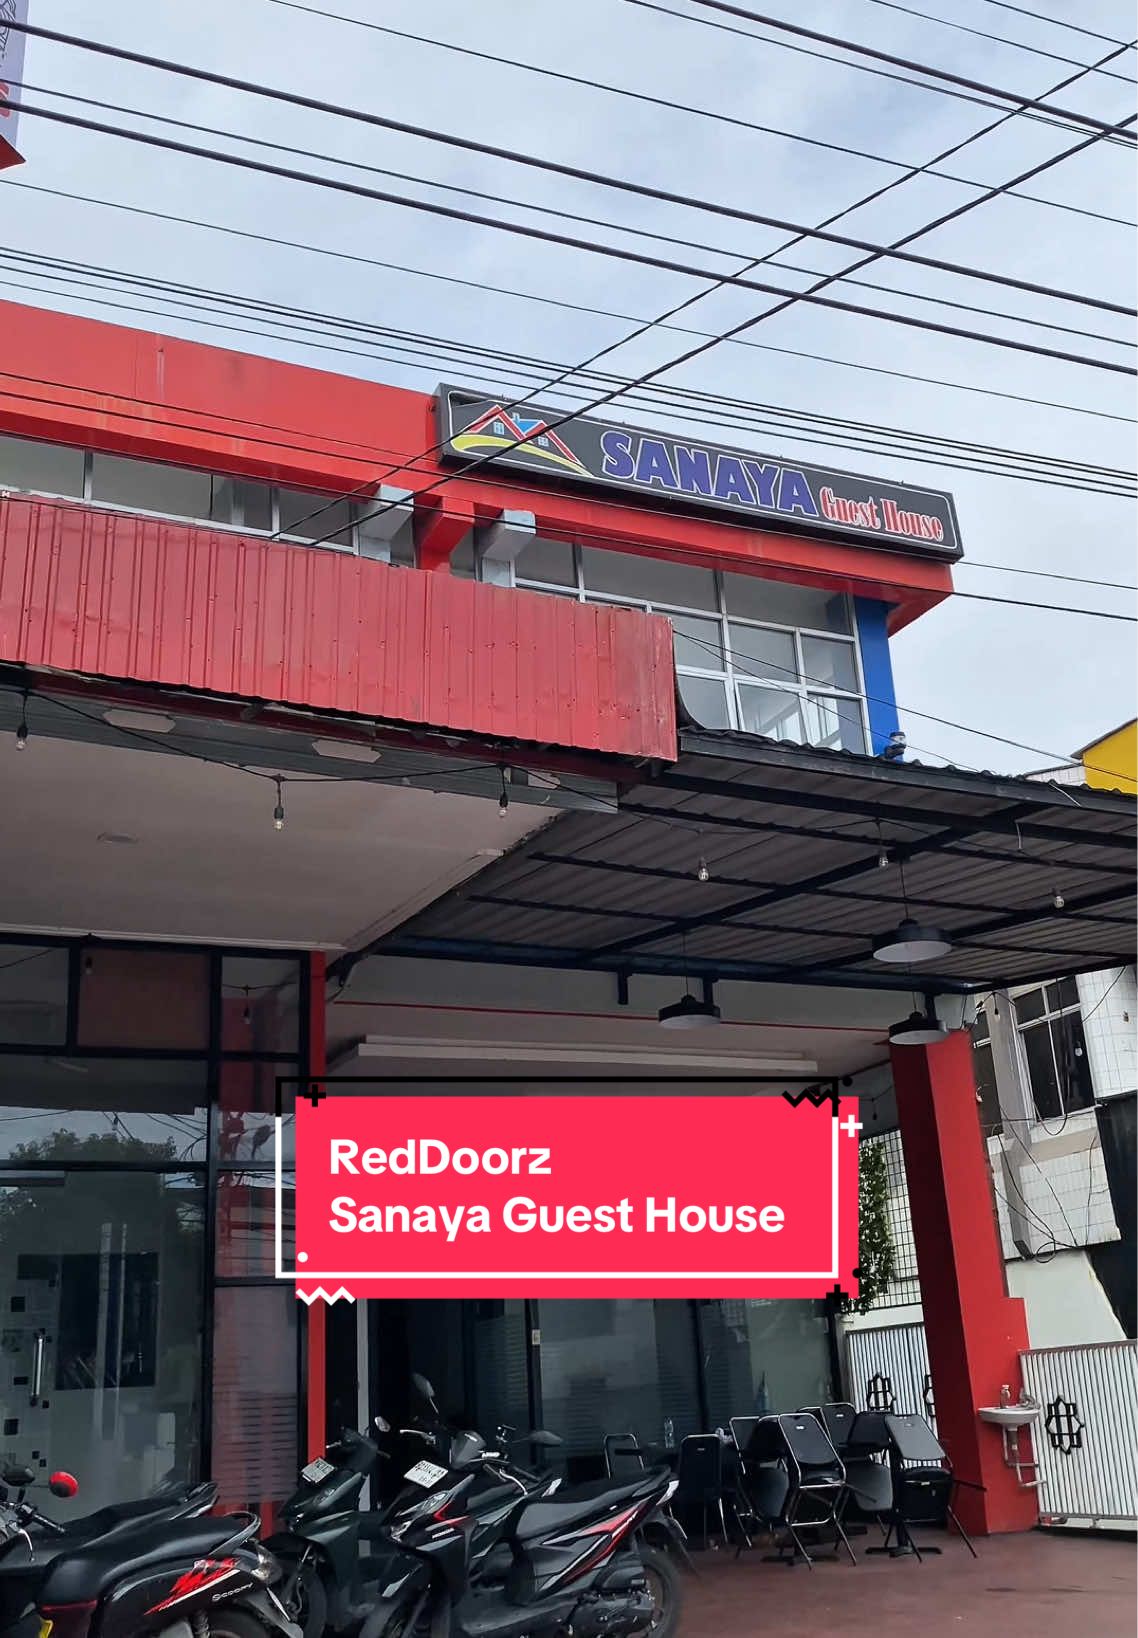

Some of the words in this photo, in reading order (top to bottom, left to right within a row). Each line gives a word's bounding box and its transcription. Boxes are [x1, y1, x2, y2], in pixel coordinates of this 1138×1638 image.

[601, 431, 819, 517] SANAYA
[819, 486, 881, 530] Guest
[880, 498, 944, 542] House
